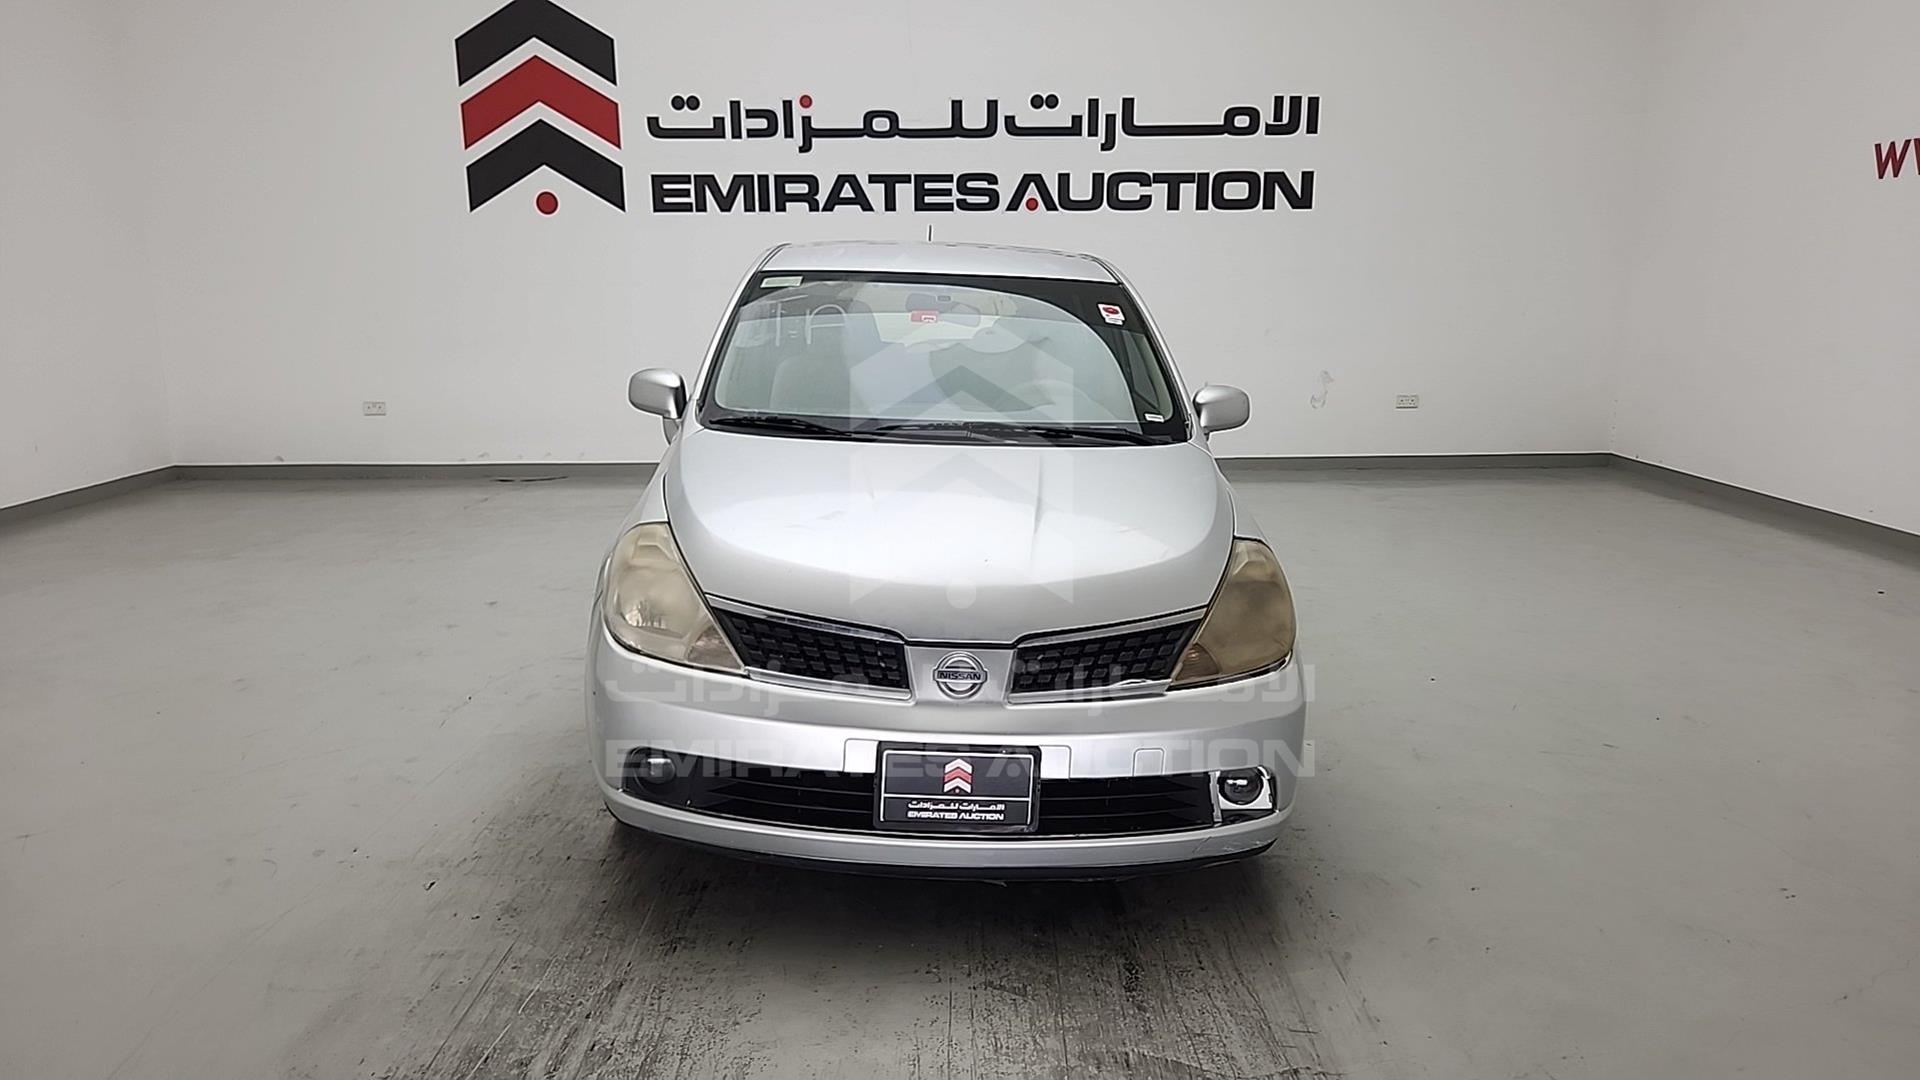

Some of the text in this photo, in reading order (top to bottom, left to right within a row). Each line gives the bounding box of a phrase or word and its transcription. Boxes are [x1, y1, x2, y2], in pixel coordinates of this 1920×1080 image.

[647, 95, 999, 153] للمزادات
[651, 171, 1315, 213] EMIRATES AUCTION
[937, 671, 981, 680] NISSAN
[959, 812, 1004, 821] AUCTION
